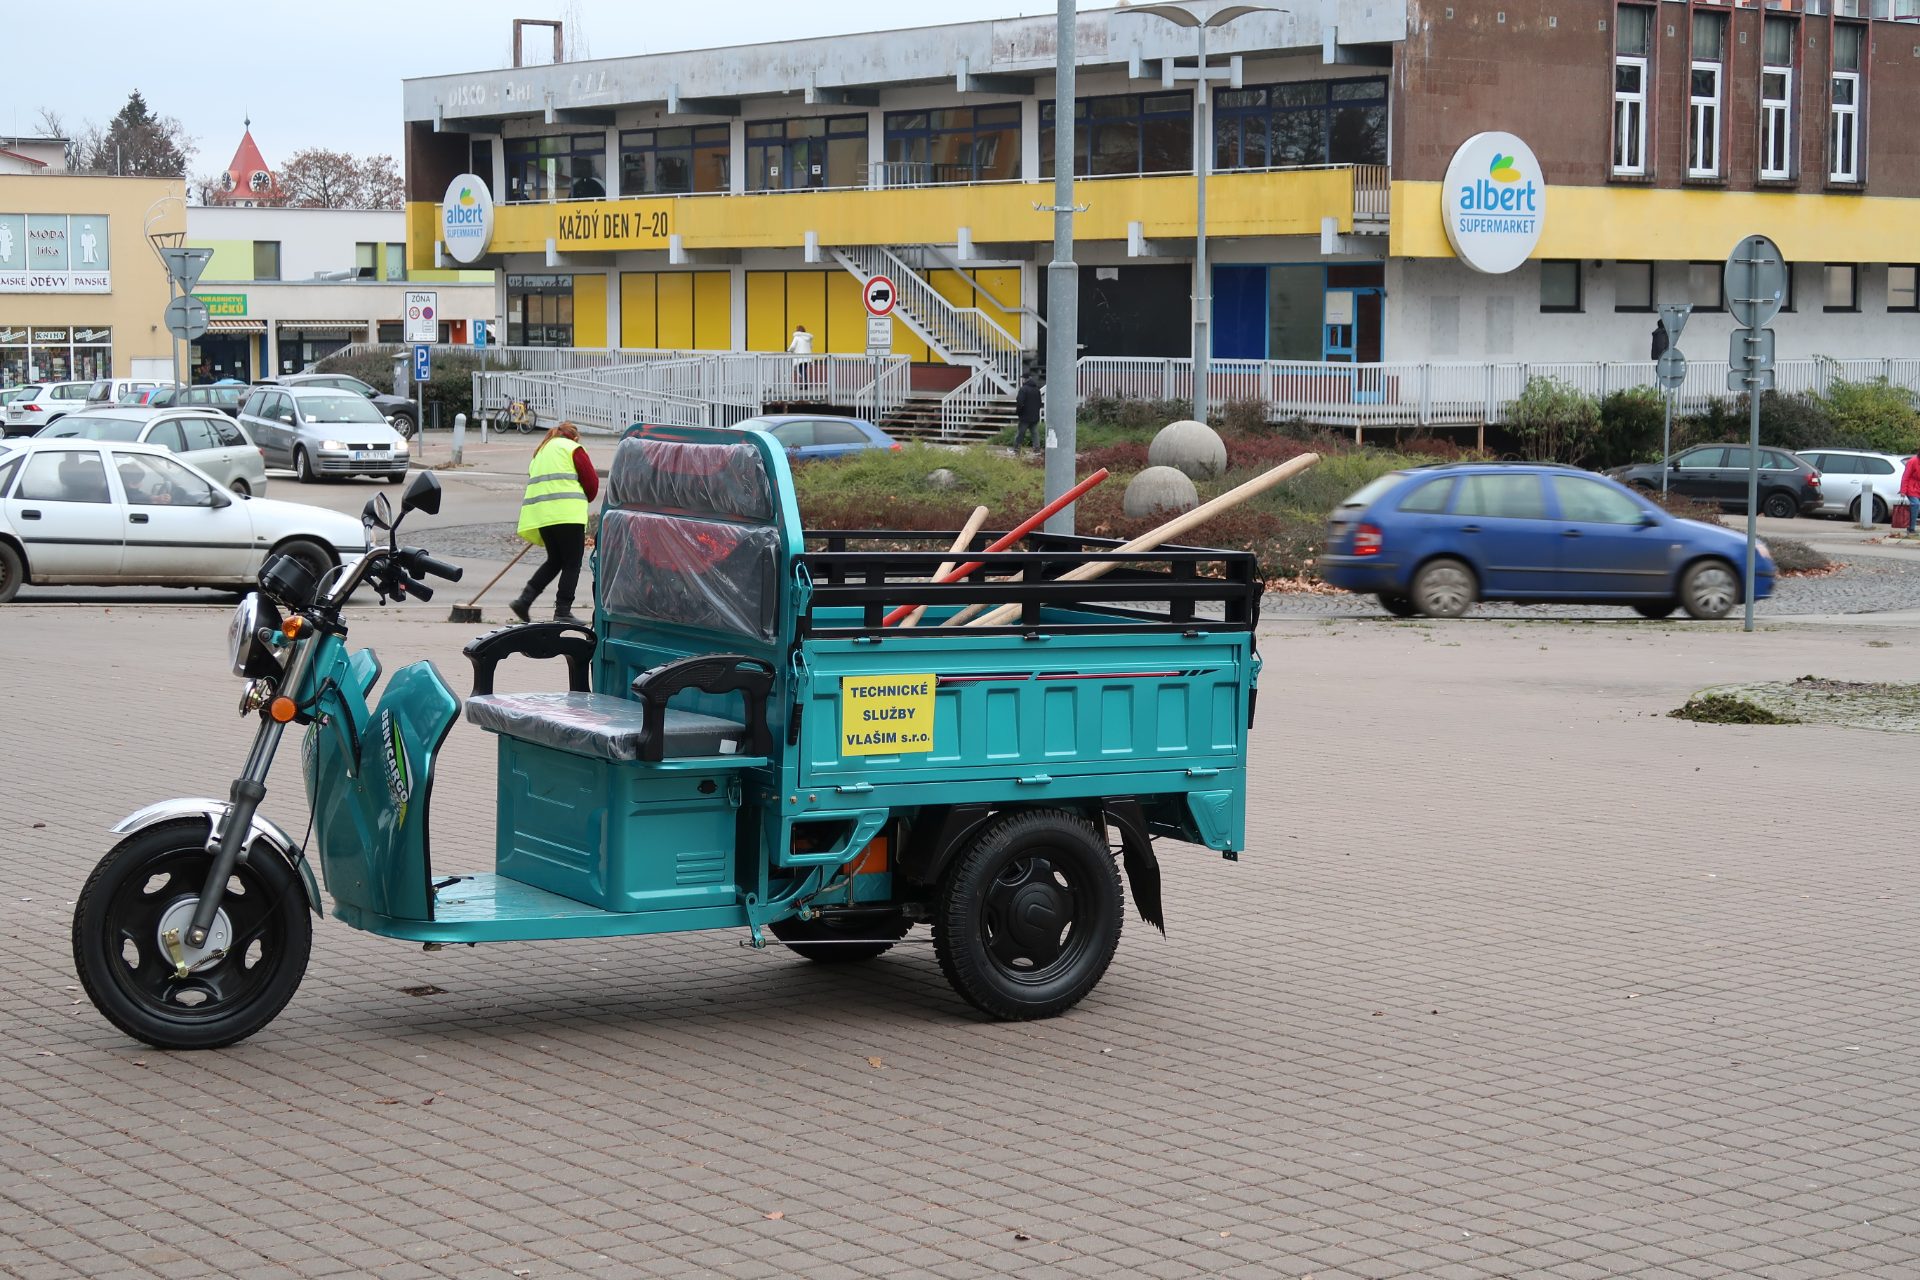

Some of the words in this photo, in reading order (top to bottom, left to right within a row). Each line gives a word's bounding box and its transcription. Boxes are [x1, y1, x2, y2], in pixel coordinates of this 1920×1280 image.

[1460, 179, 1536, 211] albert
[447, 203, 483, 224] albert
[559, 208, 599, 239] KAŽDÝ
[603, 212, 629, 238] DEN
[1460, 218, 1535, 233] SUPERMARKET
[447, 228, 483, 238] SUPERMARKET
[411, 294, 431, 303] ZÓNA
[851, 682, 928, 698] TECHNICKÉ
[863, 706, 916, 721] SLUŽBY
[846, 731, 897, 746] VLAŠIM
[901, 733, 930, 743] s.r.o.
[381, 708, 409, 803] BENYCARGO
